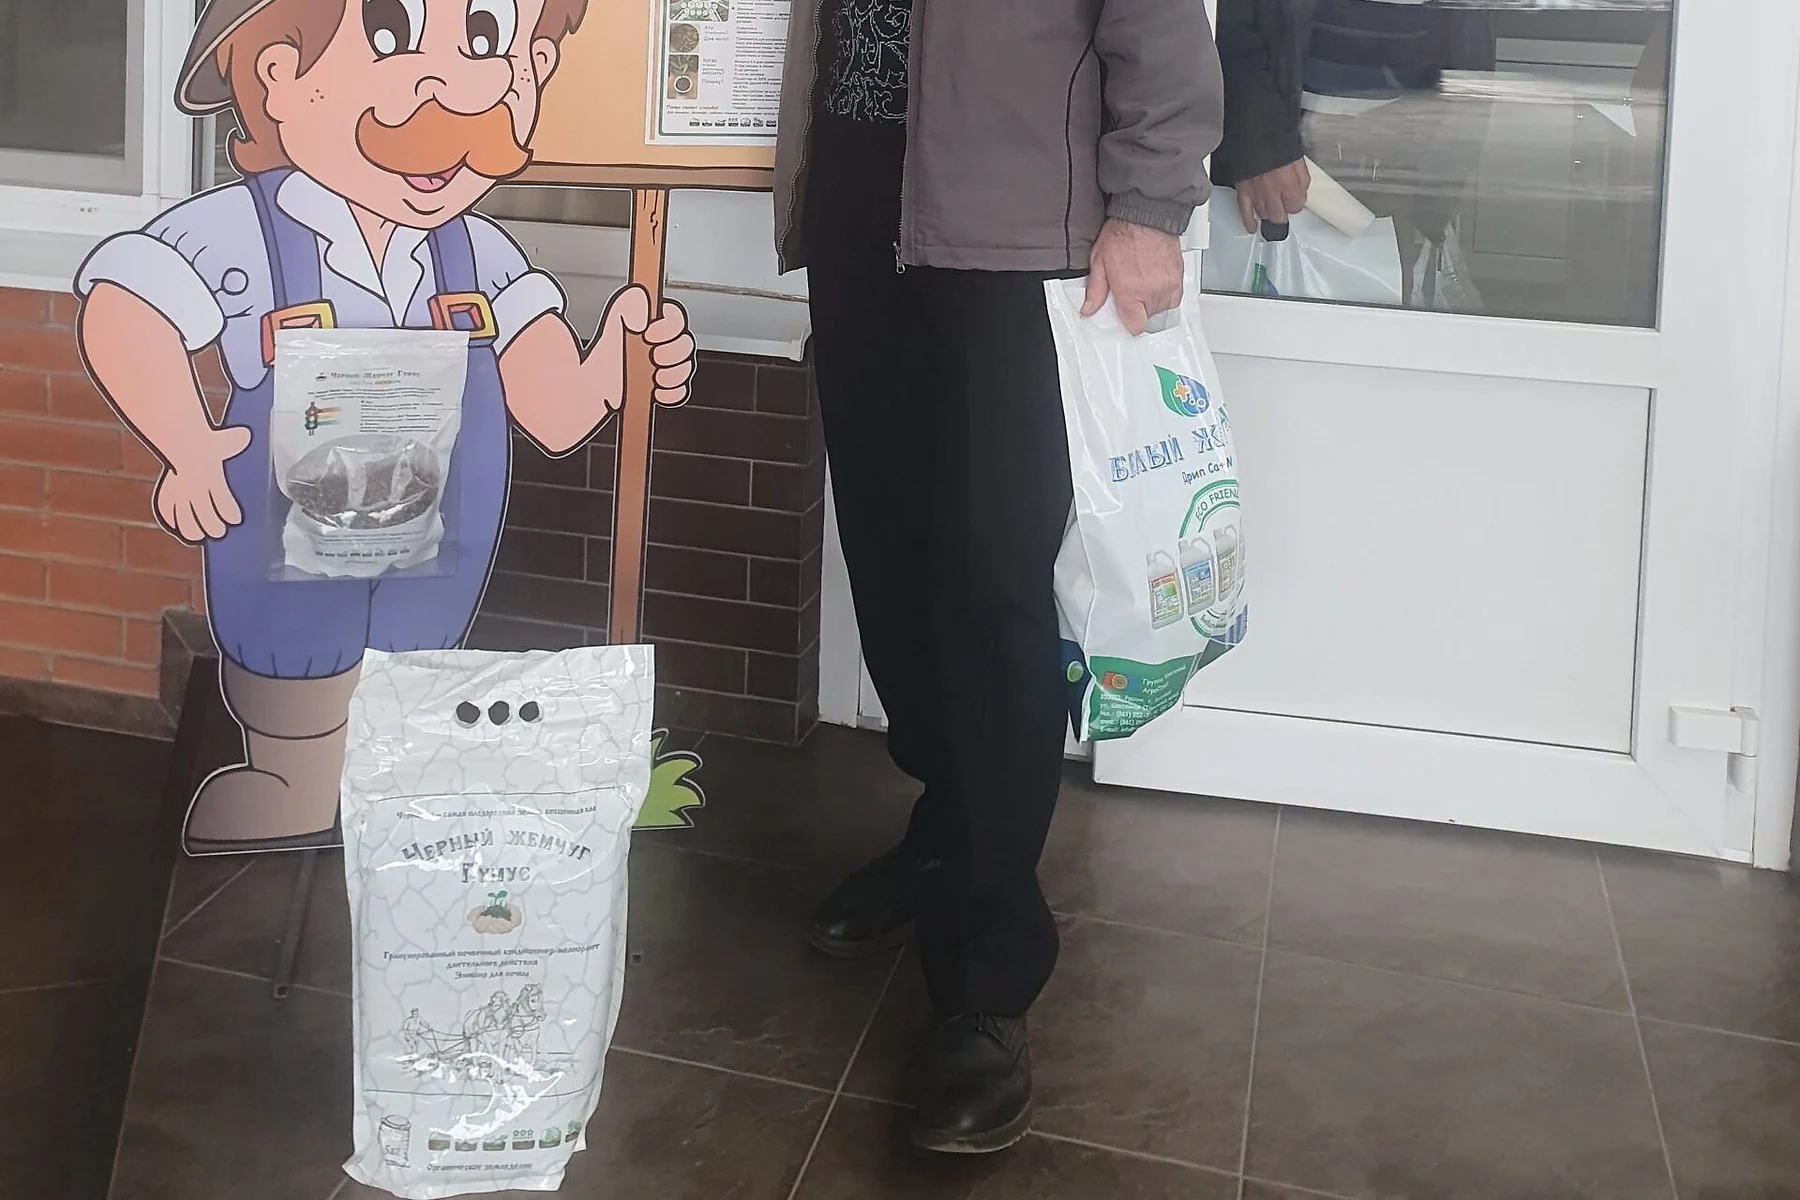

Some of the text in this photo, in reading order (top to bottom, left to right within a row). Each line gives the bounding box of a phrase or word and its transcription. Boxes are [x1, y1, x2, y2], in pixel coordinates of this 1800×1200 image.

[1182, 468, 1206, 485] Дрип
[1195, 501, 1208, 521] ECO
[401, 828, 591, 860] ЧЕРНЫЙ ЖЕМЧУГ
